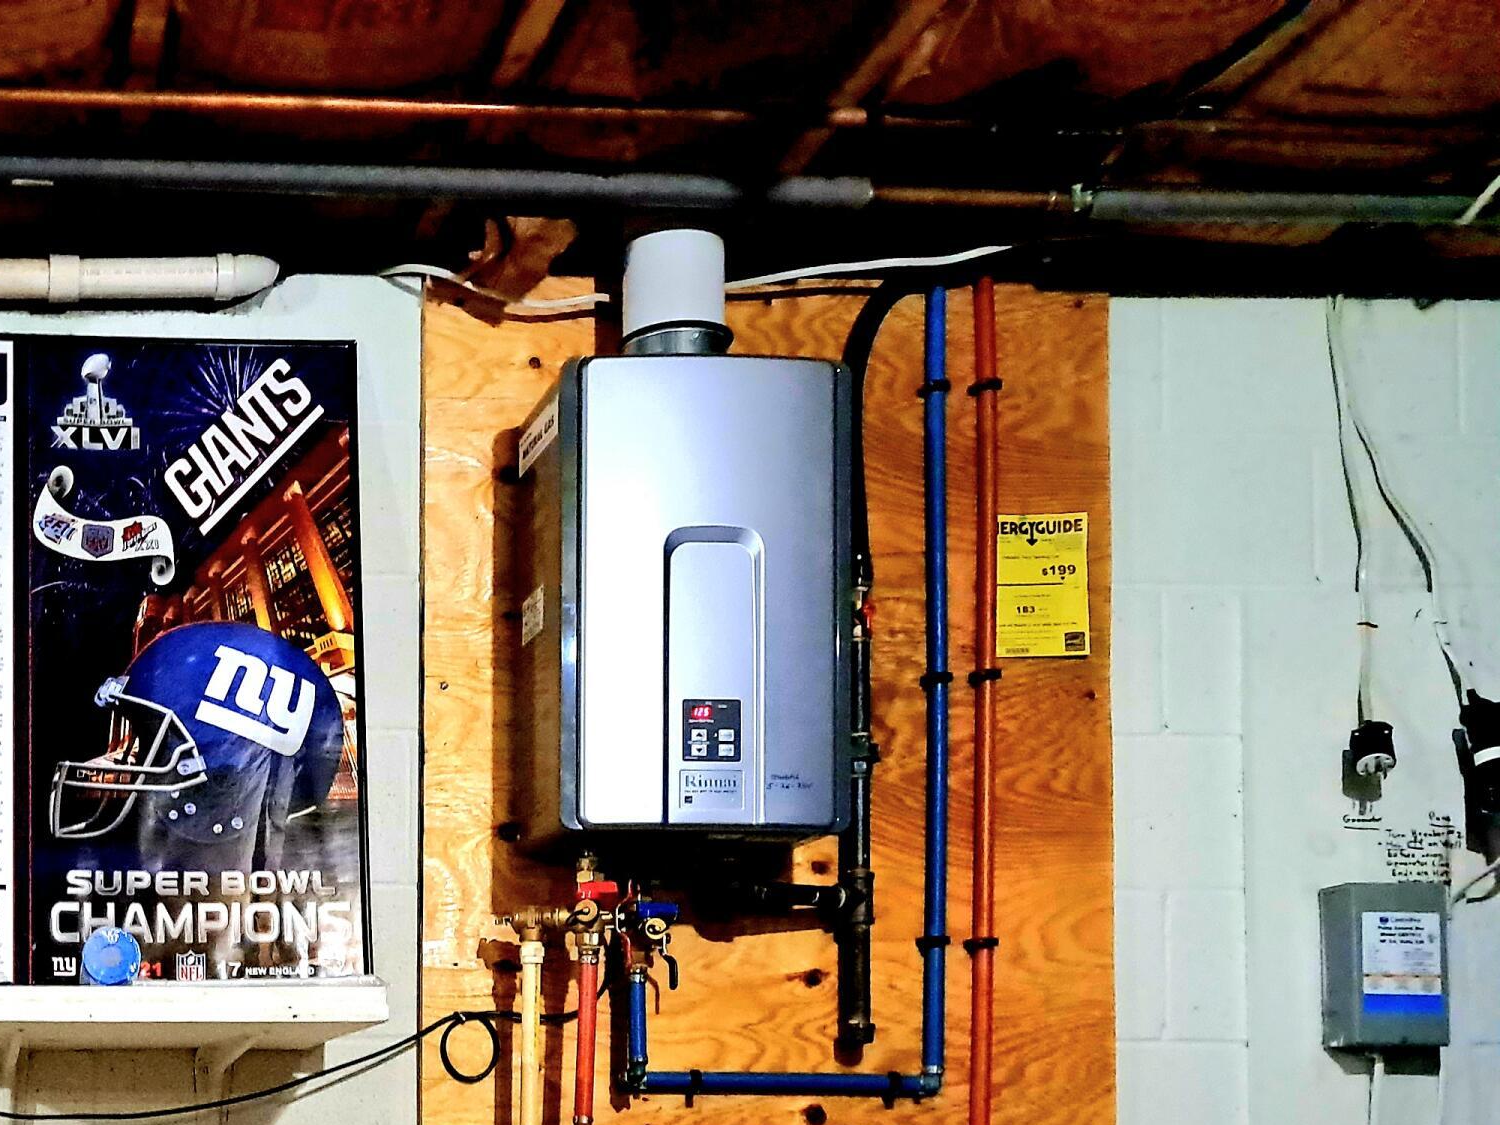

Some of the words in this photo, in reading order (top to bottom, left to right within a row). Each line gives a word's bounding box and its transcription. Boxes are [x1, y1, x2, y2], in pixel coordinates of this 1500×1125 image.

[50, 425, 141, 450] XLVI
[164, 357, 313, 521] GIANTS
[1041, 564, 1077, 577] $199
[684, 774, 738, 788] Rinnai
[66, 869, 210, 896] SUPER
[220, 869, 337, 896] BOWL
[50, 900, 353, 945] CHAMPIONS
[179, 965, 204, 981] NFL
